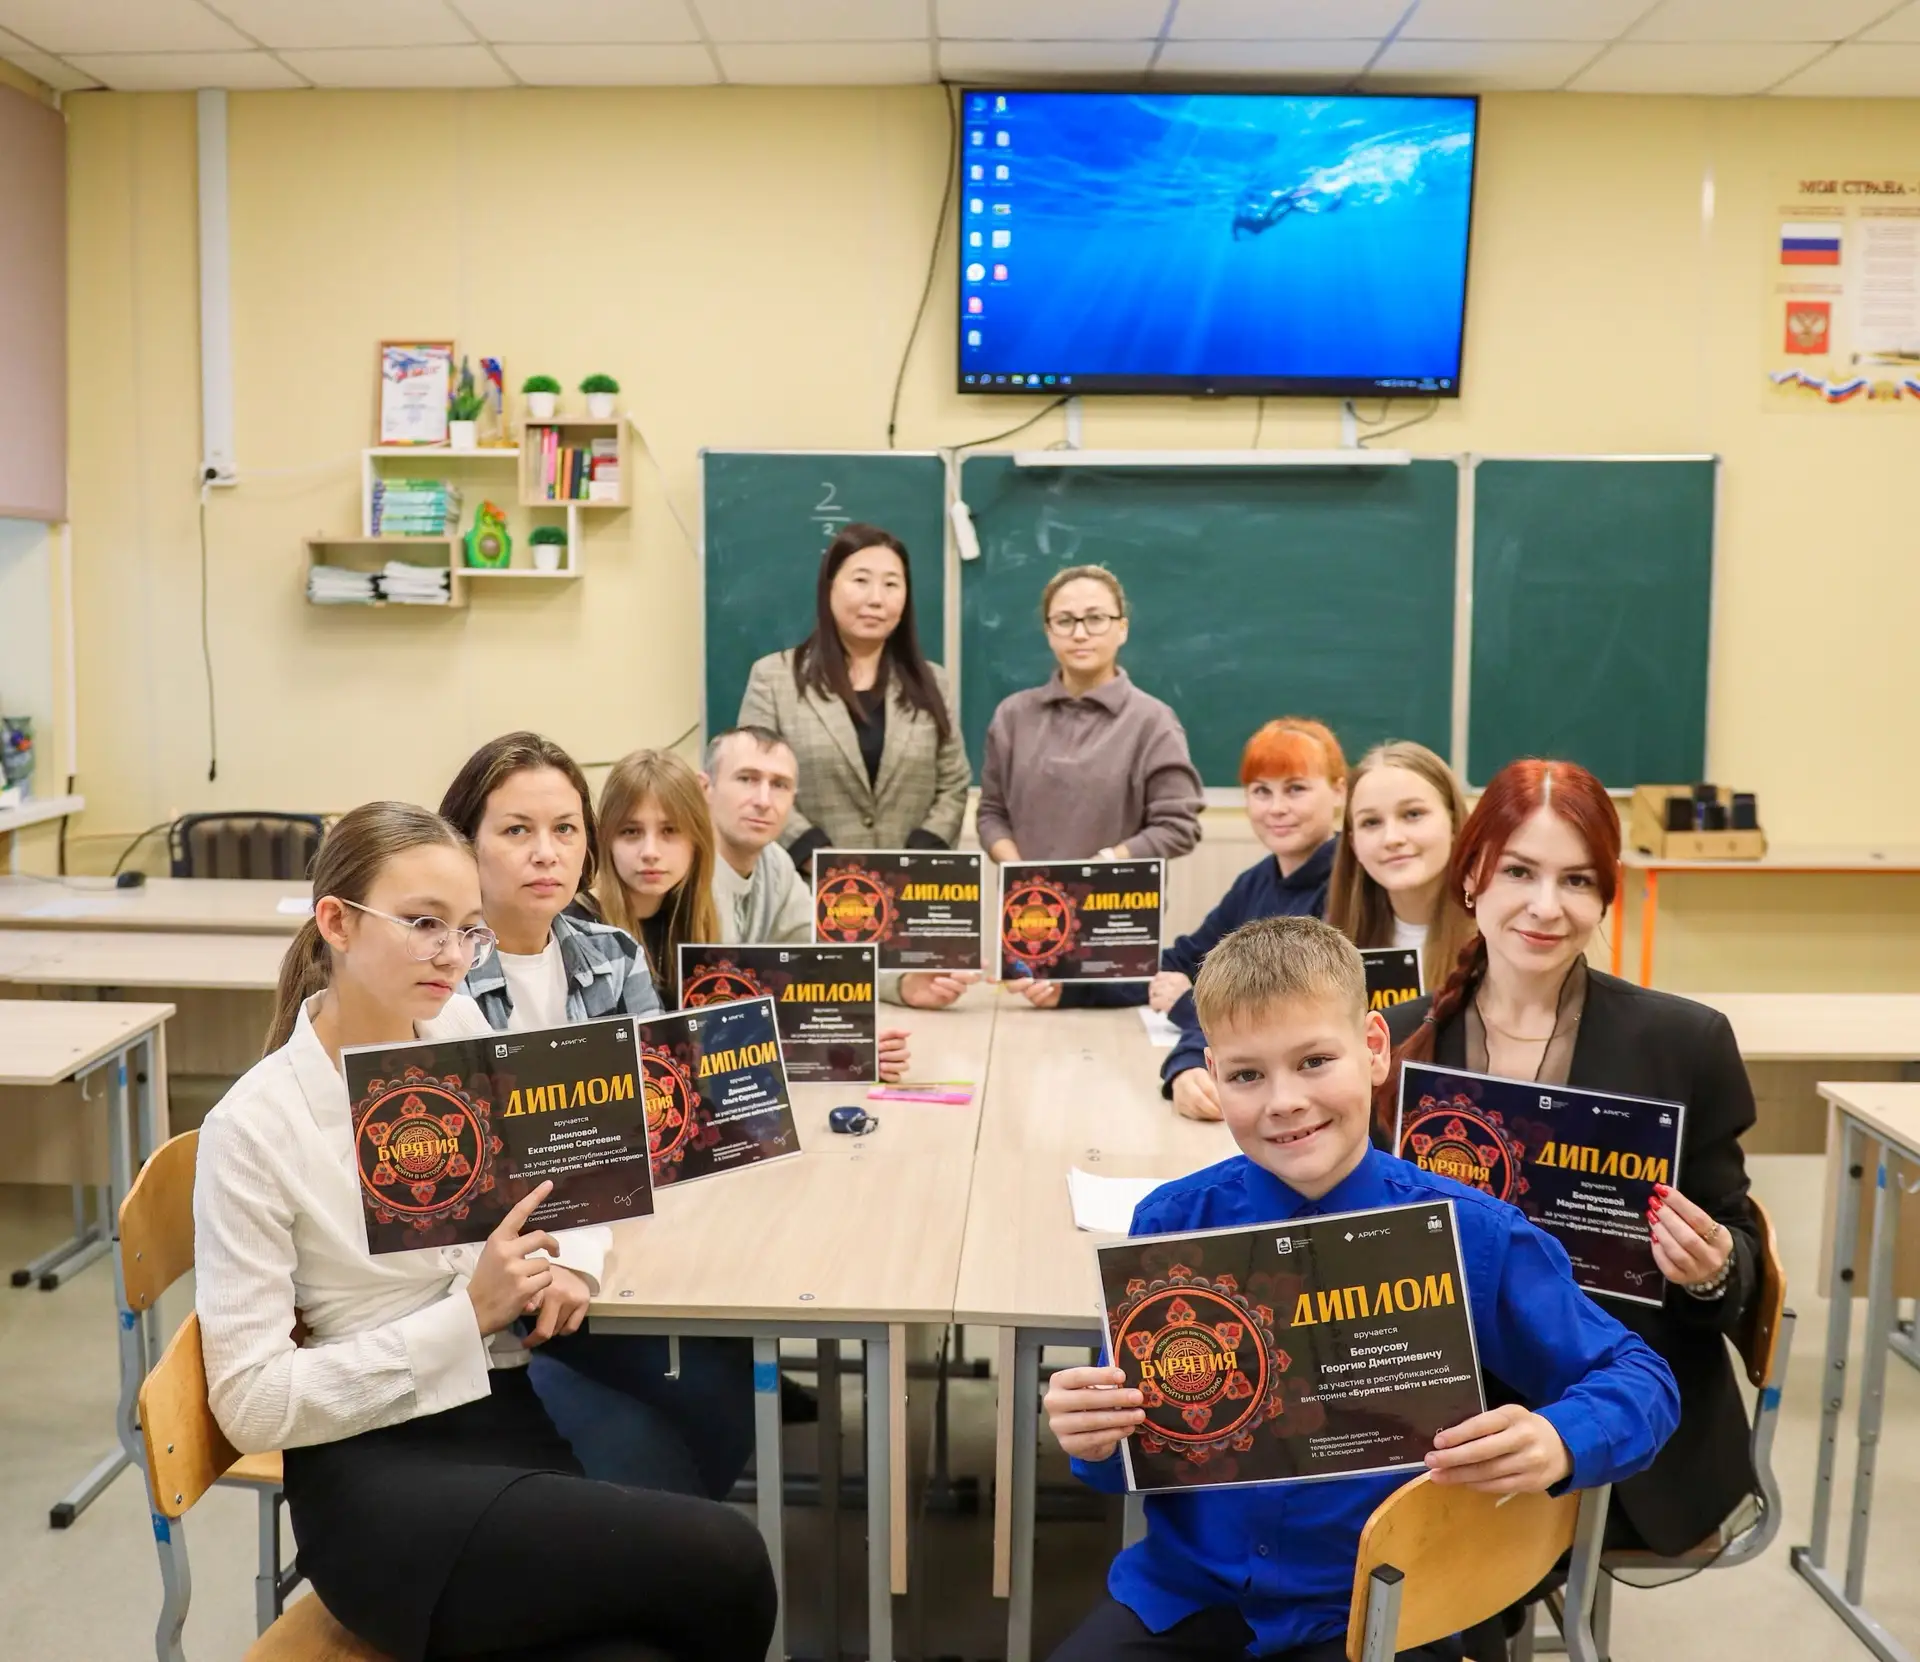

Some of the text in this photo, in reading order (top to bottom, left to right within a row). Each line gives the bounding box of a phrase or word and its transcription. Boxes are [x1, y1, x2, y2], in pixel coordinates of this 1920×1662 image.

[815, 481, 843, 511] 2
[901, 883, 979, 901] ДИПЛОМ
[1082, 892, 1159, 911] ДИПЛОМ
[780, 983, 872, 1003] ДИПЛОМ
[1370, 987, 1418, 1010] ЛОМ
[560, 1037, 587, 1046] АРИГУС
[698, 1041, 777, 1078] ДИПЛОМ
[504, 1073, 634, 1118] ДИПЛОМ
[553, 1116, 589, 1127] вручается
[527, 1134, 621, 1155] Екатерине Сергеевне
[549, 1127, 598, 1142] Даниловой
[378, 1137, 459, 1162] БУРЯТИЯ
[533, 1159, 561, 1168] участие
[568, 1146, 628, 1163] республиканской
[509, 1169, 547, 1180] викторине
[583, 1160, 604, 1168] войти
[1417, 1155, 1490, 1182] БУРЯТИЯ
[1535, 1141, 1669, 1184] ДИПЛОМ
[1572, 1191, 1625, 1206] Белоусовой
[1586, 1203, 1640, 1218] Викторовне
[1358, 1228, 1391, 1239] АРИГУС
[1290, 1272, 1455, 1327] ДИПЛОМ
[1353, 1326, 1398, 1339] вручается
[1350, 1341, 1409, 1357] Белоусову
[1140, 1351, 1237, 1380] БУРЯТИЯ
[1320, 1349, 1443, 1374] Георгию Дмитриевичу
[1300, 1391, 1347, 1403] викторине
[1348, 1386, 1393, 1398] «Бурятия:
[1394, 1381, 1420, 1391] войти
[1428, 1373, 1471, 1386] историю»
[1318, 1383, 1329, 1391] за
[1330, 1379, 1365, 1391] участие
[1373, 1365, 1450, 1385] республиканской
[1309, 1431, 1380, 1443] Генеральный директор
[1311, 1439, 1373, 1451] телерадиокомпании
